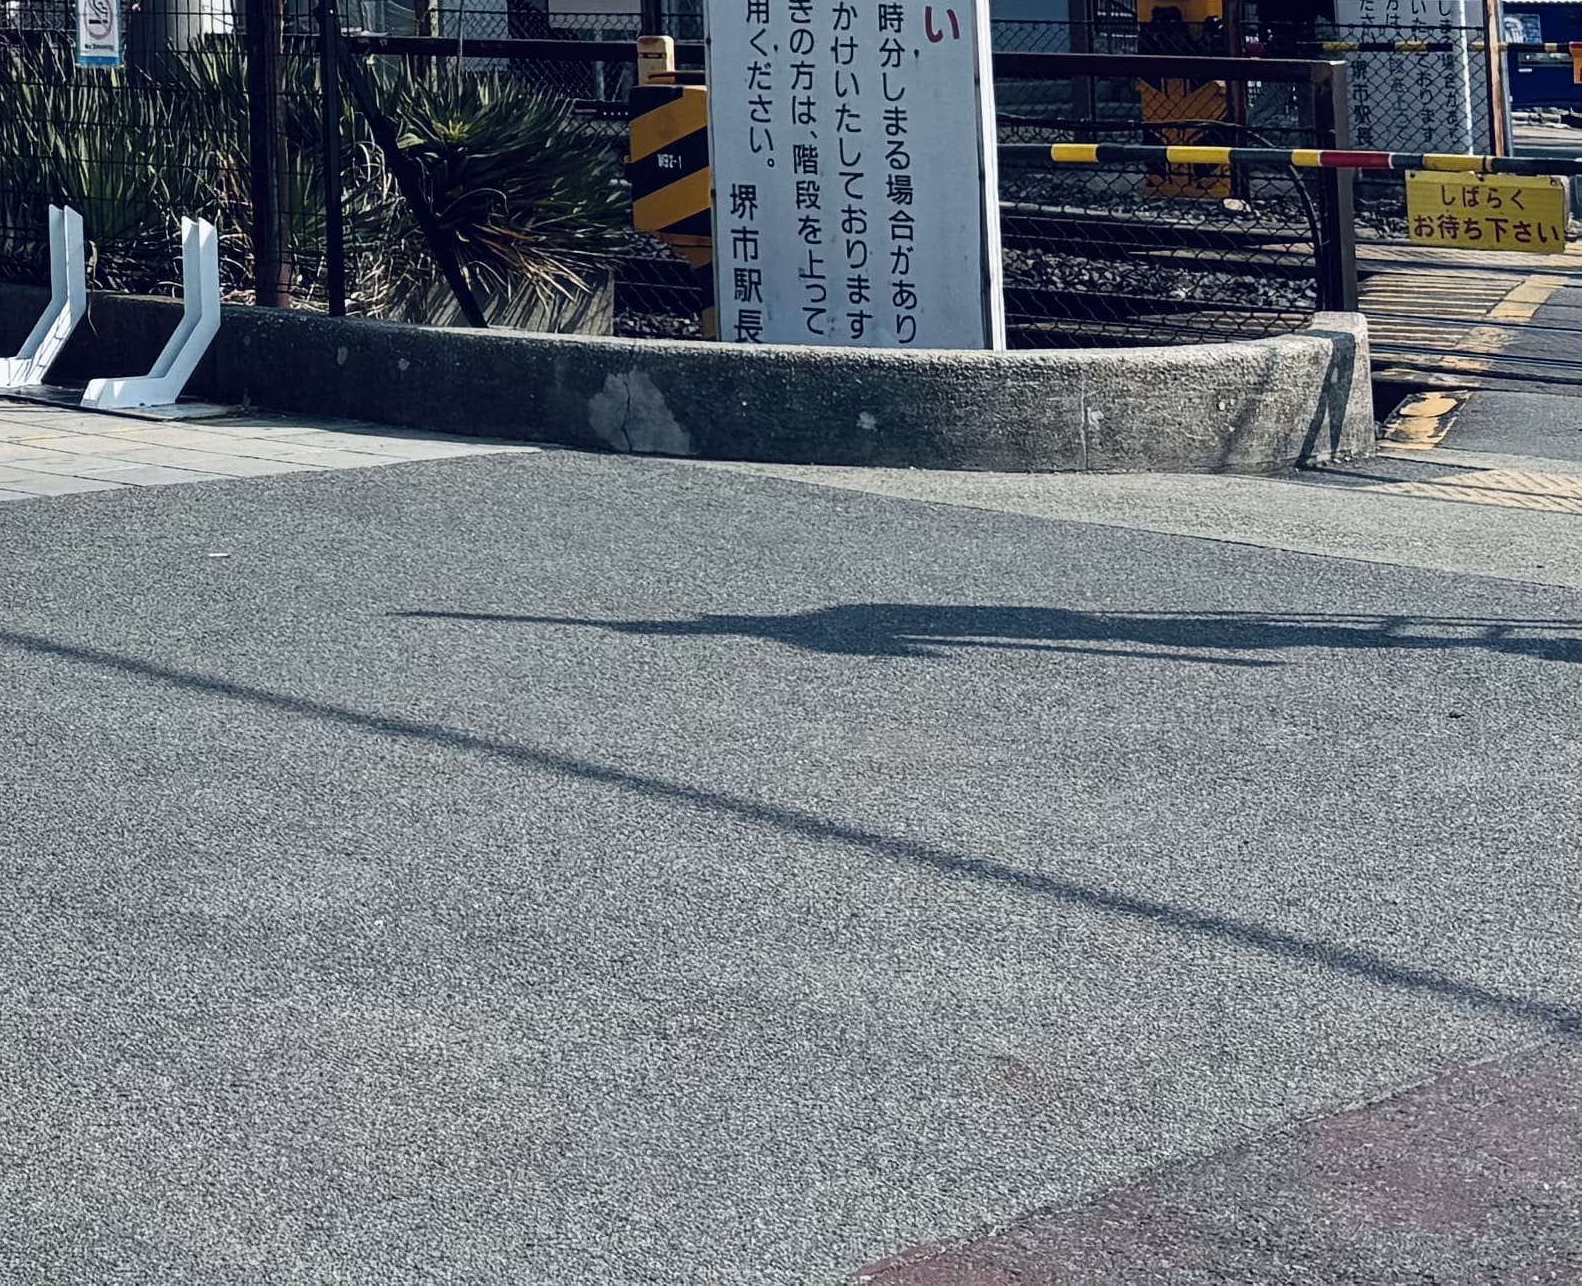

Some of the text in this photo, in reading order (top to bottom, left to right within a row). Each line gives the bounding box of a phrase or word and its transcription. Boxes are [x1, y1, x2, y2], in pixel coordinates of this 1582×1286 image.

[1441, 185, 1525, 210] しばらく
[1414, 214, 1559, 243] お待ち下さい
[730, 183, 764, 344] 堺市駅長
